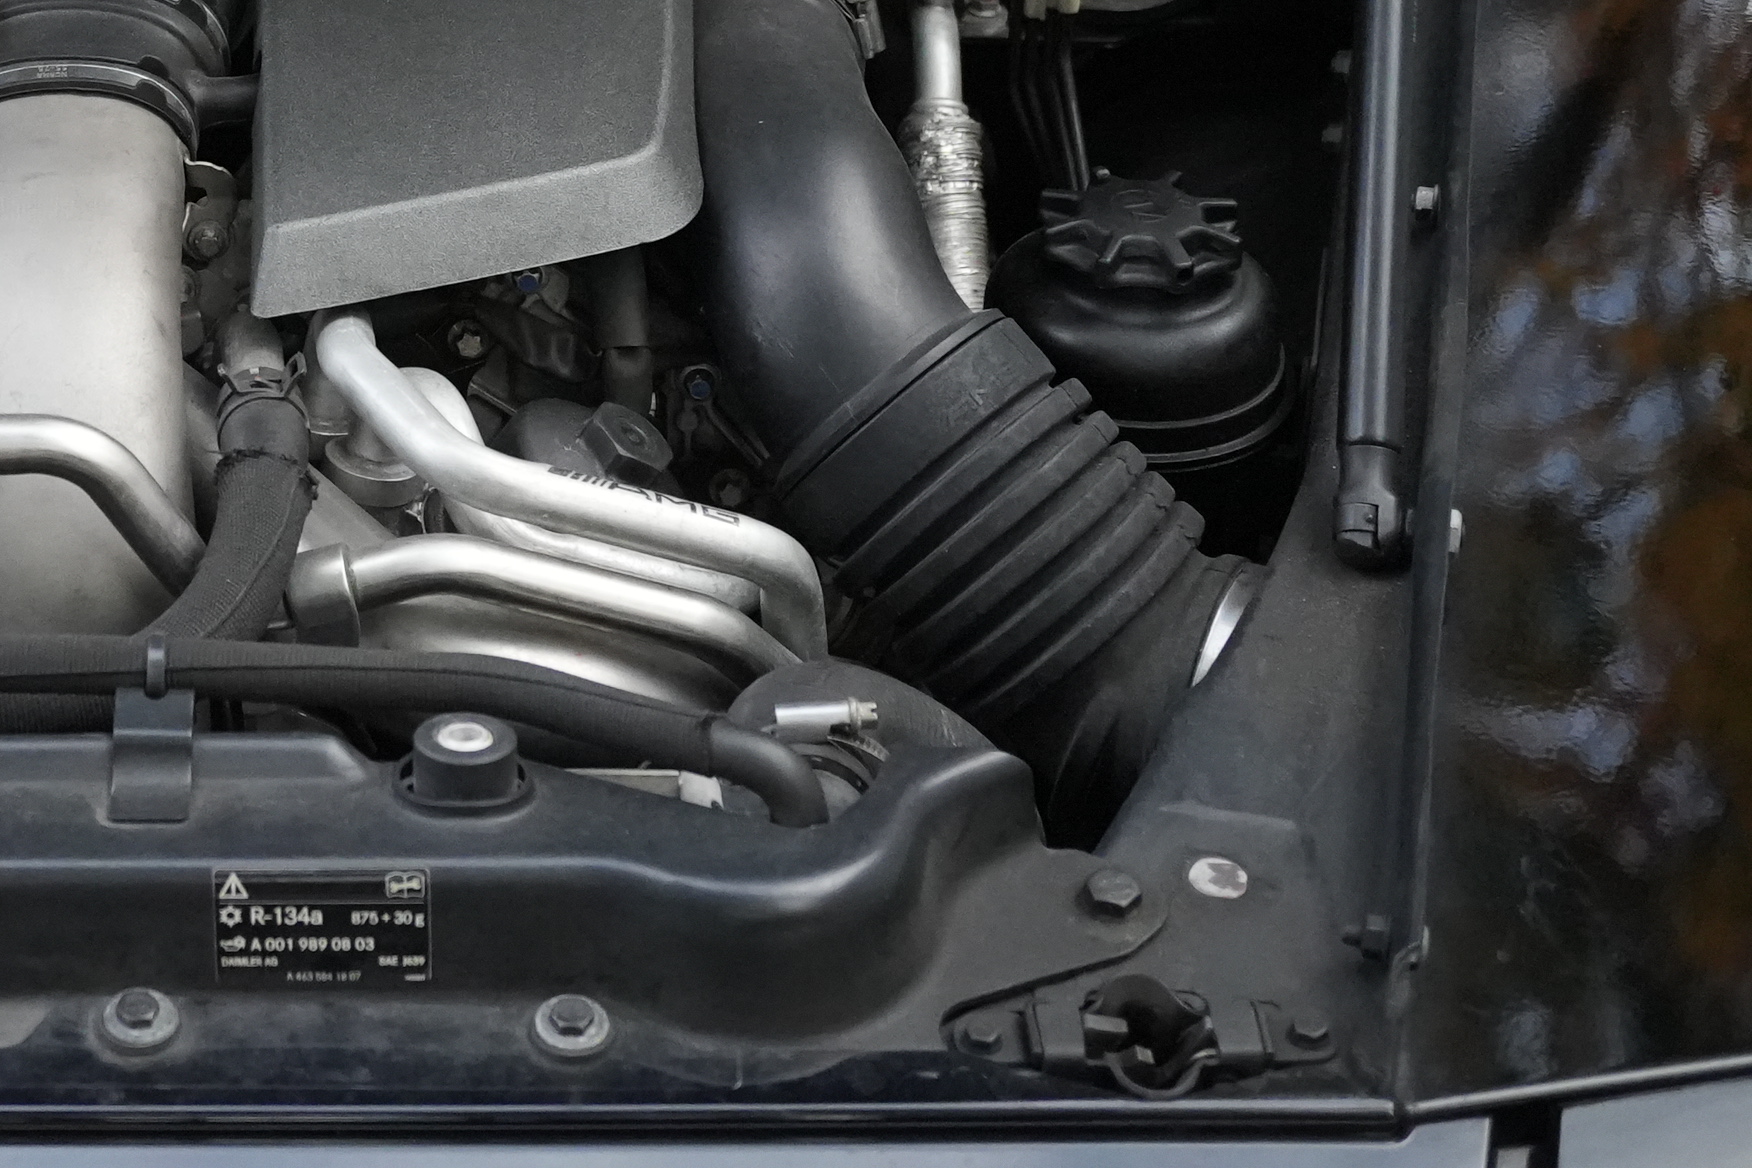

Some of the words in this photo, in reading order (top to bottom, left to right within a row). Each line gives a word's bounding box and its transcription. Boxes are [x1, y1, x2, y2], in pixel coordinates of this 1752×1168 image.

[250, 906, 324, 926] R-134a
[250, 937, 262, 952] A
[265, 937, 294, 952] 001
[298, 937, 327, 952] 989
[355, 937, 375, 952] 03
